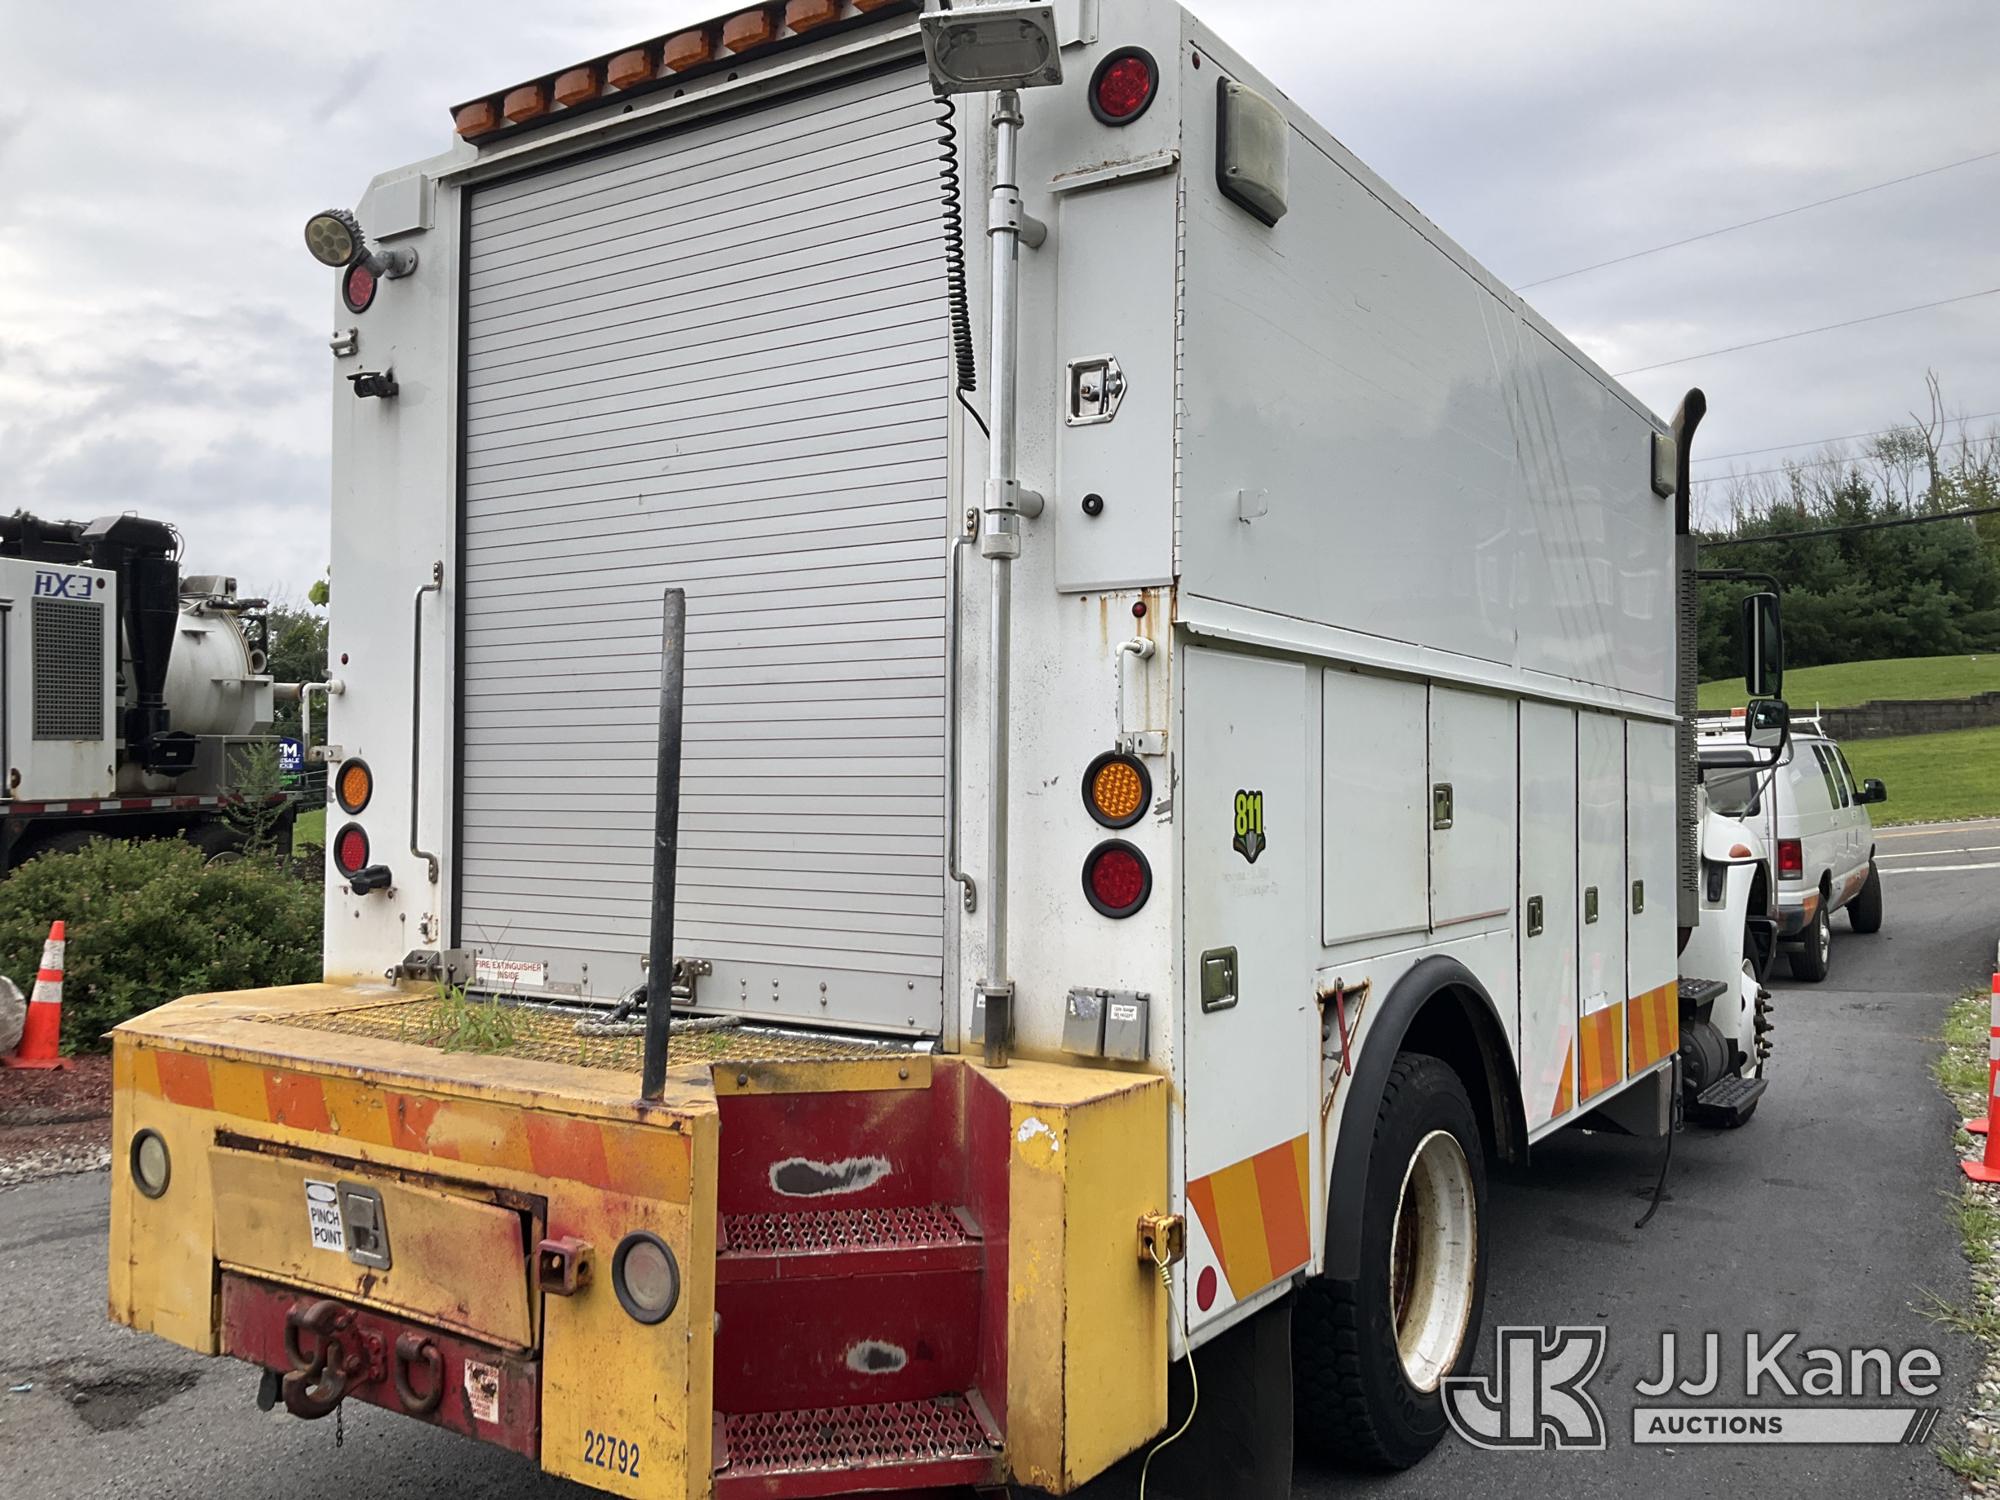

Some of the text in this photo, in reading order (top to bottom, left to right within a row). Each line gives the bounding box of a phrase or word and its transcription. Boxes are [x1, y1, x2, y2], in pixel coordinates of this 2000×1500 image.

[1235, 791, 1263, 836] 811
[476, 960, 542, 972] FIRE EXTINGUISHER
[497, 971, 520, 980] INSIDE
[311, 1207, 340, 1226] PINCH
[314, 1226, 342, 1246] POINT
[584, 1429, 640, 1478] 22792
